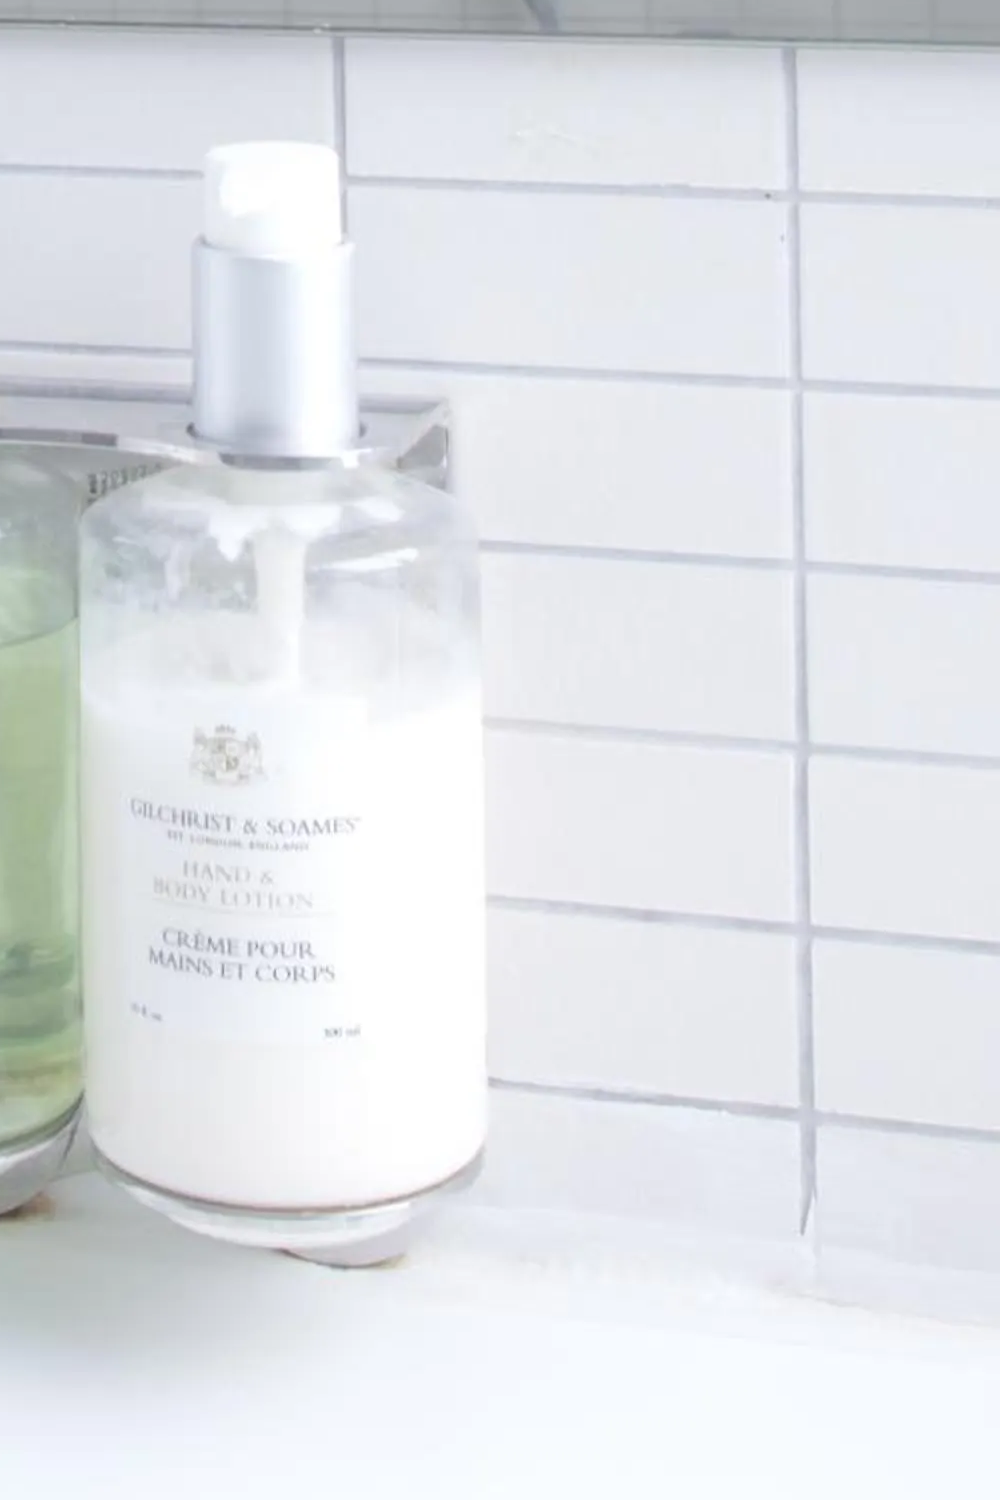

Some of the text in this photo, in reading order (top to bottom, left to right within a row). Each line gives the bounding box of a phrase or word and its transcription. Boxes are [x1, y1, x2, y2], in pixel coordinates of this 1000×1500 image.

[130, 798, 236, 833] GILCHRIST
[243, 819, 258, 835] &
[182, 859, 274, 885] HAND &
[153, 876, 314, 910] BODY LOTION
[161, 926, 316, 961] CRÈME POUR
[149, 945, 337, 984] MAINS ET CORPS
